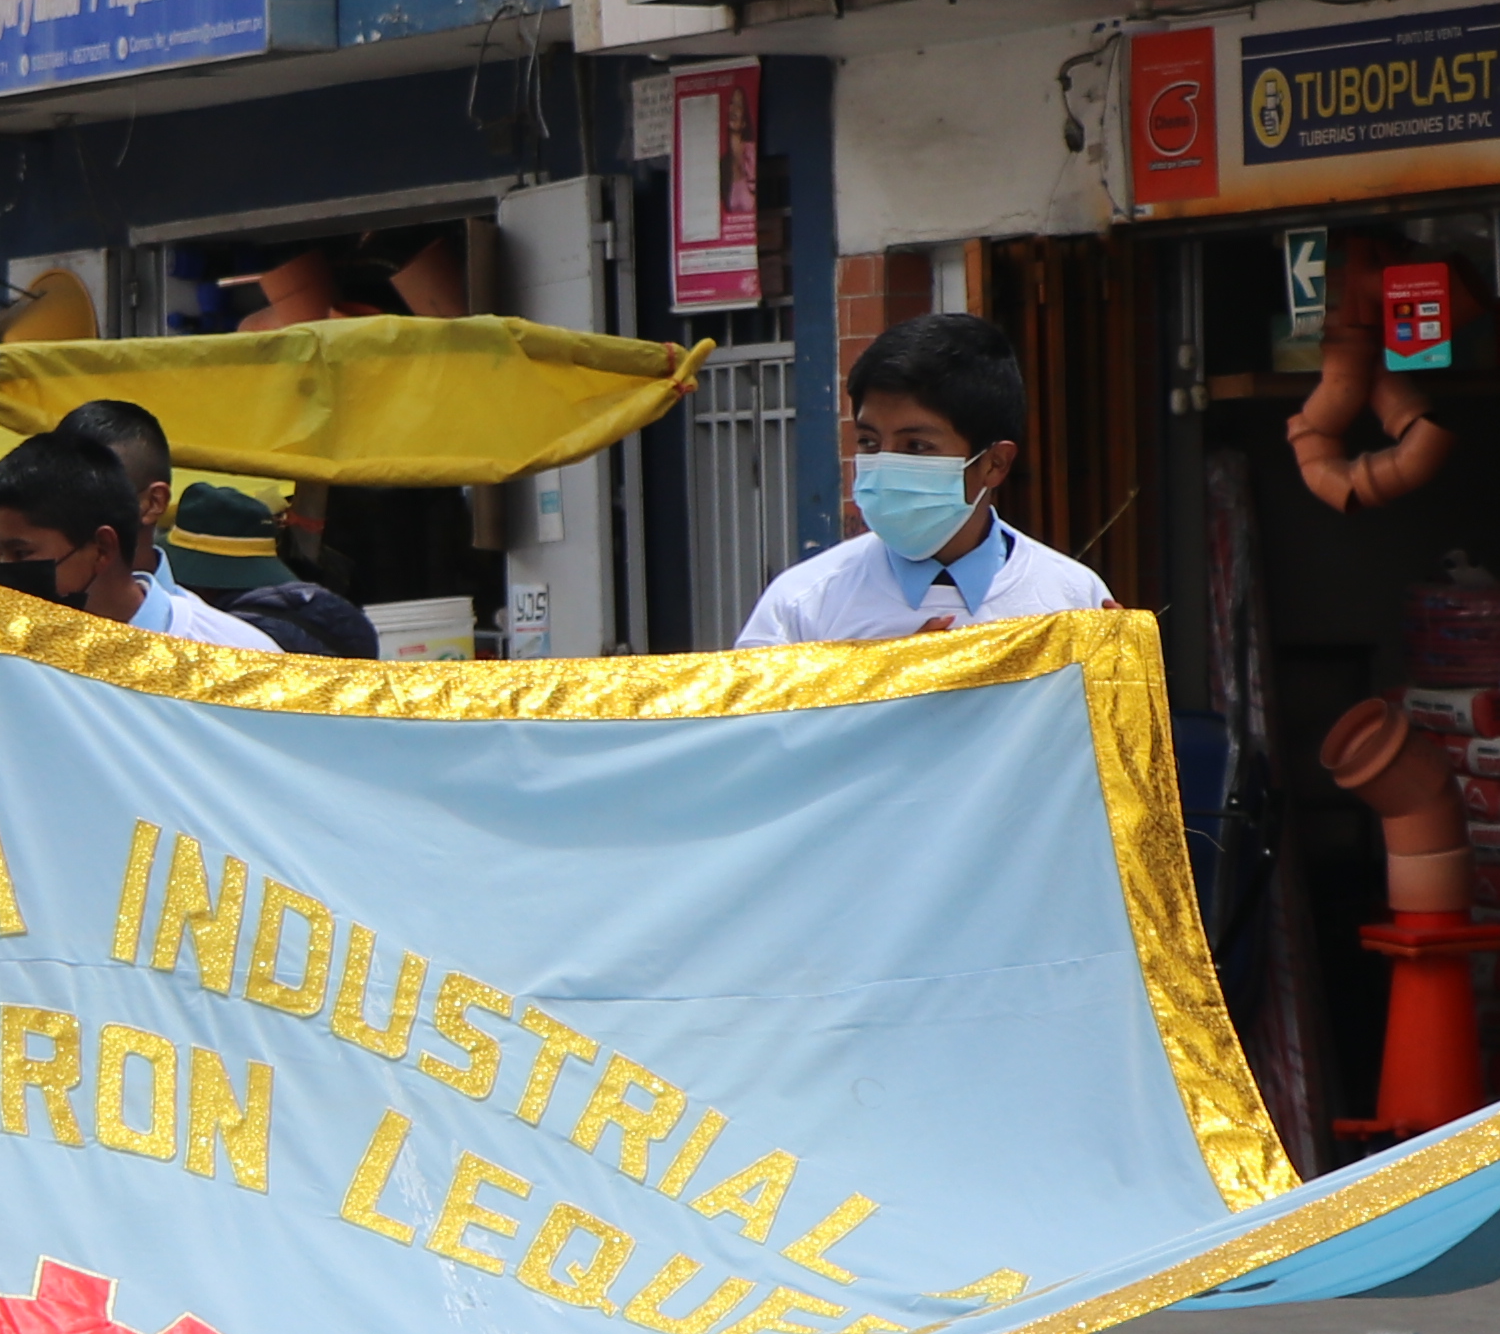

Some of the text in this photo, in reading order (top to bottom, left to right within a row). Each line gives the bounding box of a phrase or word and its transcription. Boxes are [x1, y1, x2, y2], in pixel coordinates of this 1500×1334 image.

[1437, 26, 1463, 42] VENTA
[1295, 50, 1499, 121] TUBOPLAST
[1359, 109, 1493, 141] Y CONEXIONES DE PVC
[108, 817, 881, 1287] INDUSTRIAL
